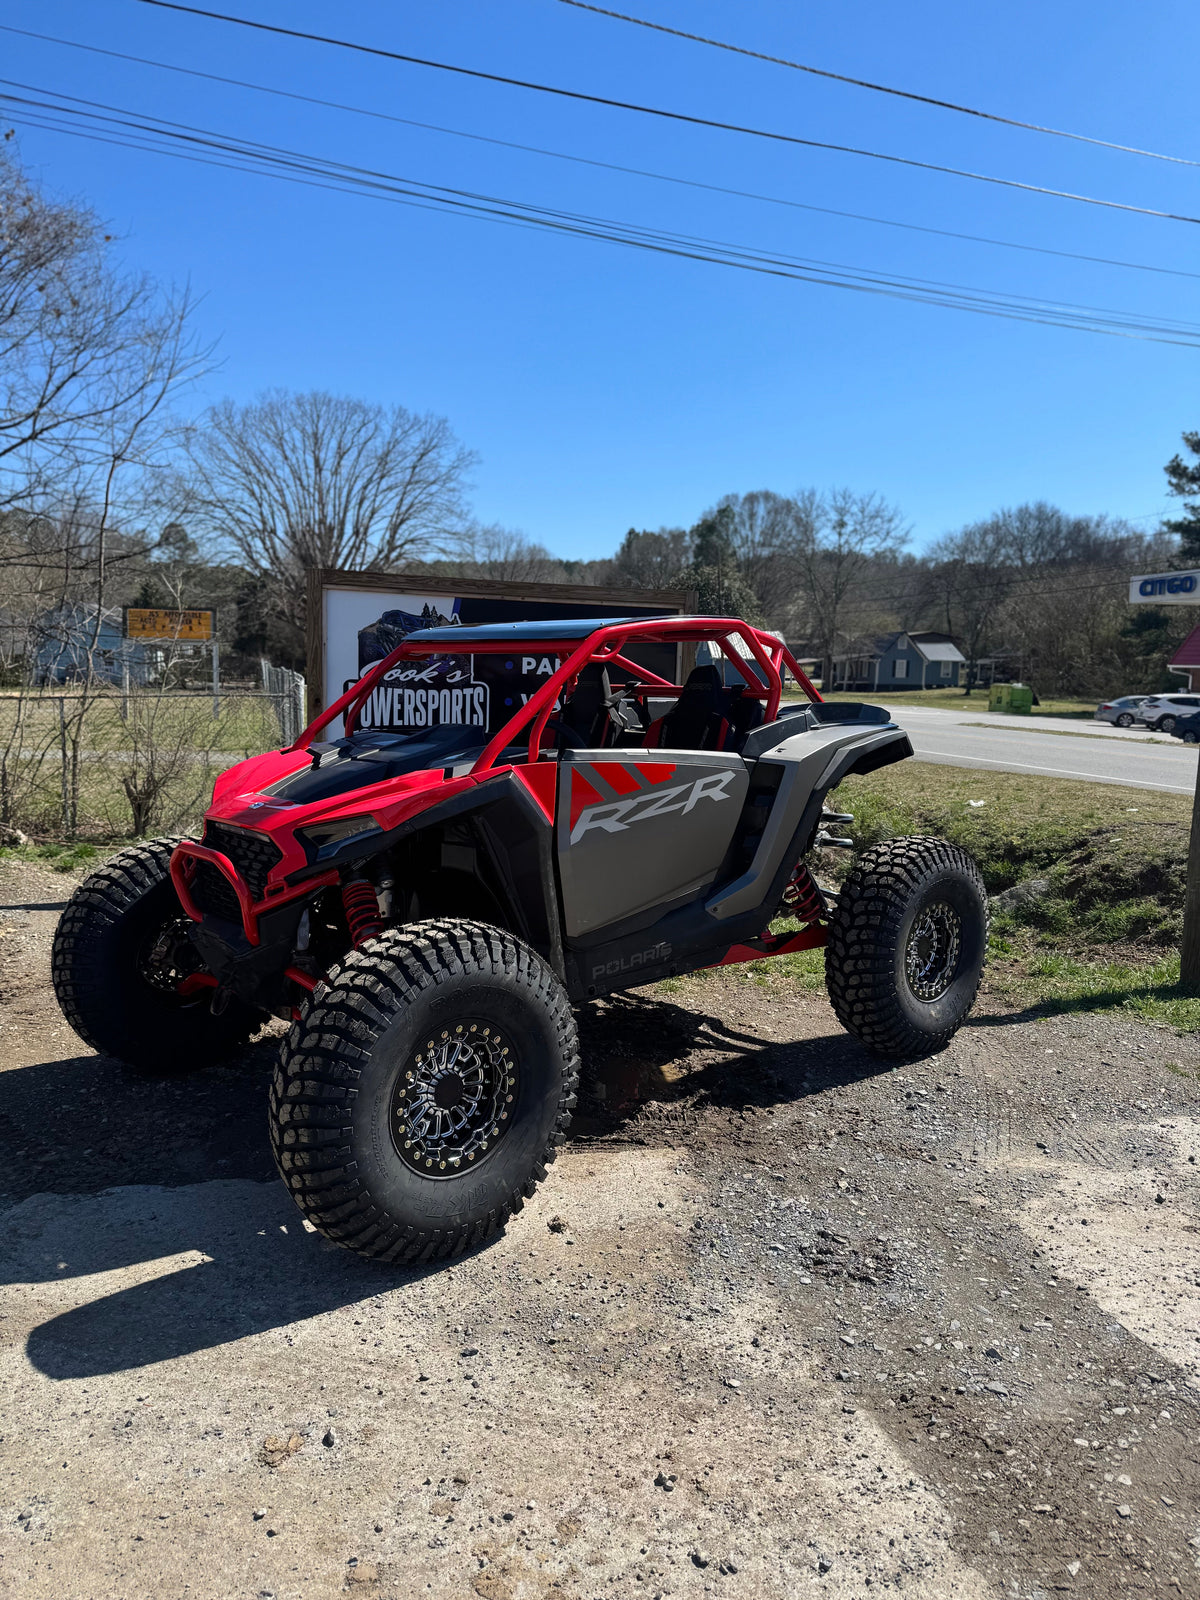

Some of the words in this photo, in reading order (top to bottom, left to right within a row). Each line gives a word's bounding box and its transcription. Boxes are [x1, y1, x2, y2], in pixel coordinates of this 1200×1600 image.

[1139, 576, 1198, 597] CITGO
[348, 682, 485, 728] OWERSPORTS
[570, 770, 736, 846] RZR
[592, 941, 673, 980] POLARIS
